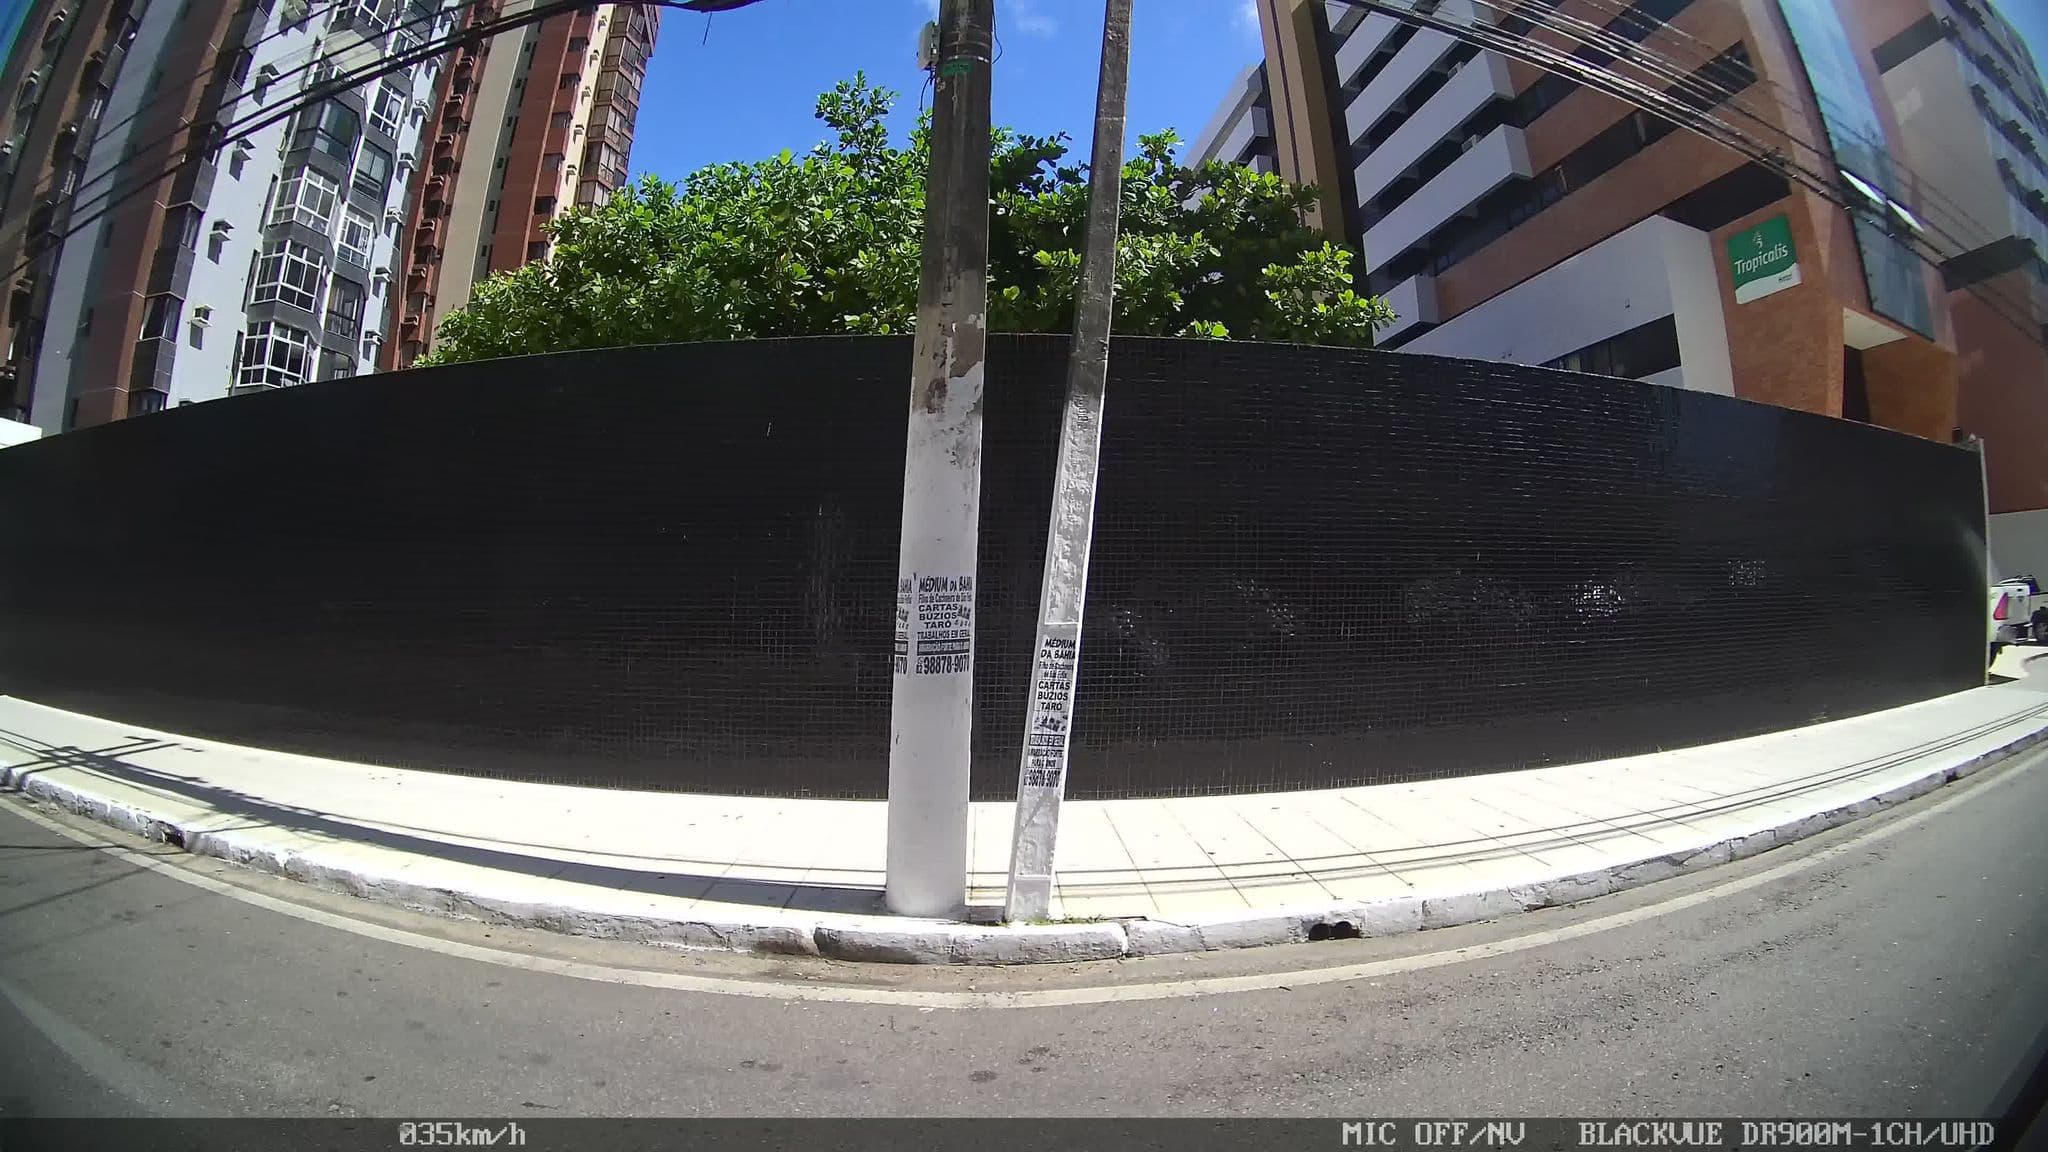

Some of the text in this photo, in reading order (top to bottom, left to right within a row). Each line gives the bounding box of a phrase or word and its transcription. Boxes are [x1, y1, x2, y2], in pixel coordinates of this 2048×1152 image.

[1734, 243, 1789, 275] Tropicalis
[918, 603, 958, 612] CARTAS
[1040, 649, 1052, 659] DA
[1038, 680, 1071, 691] CARTAS
